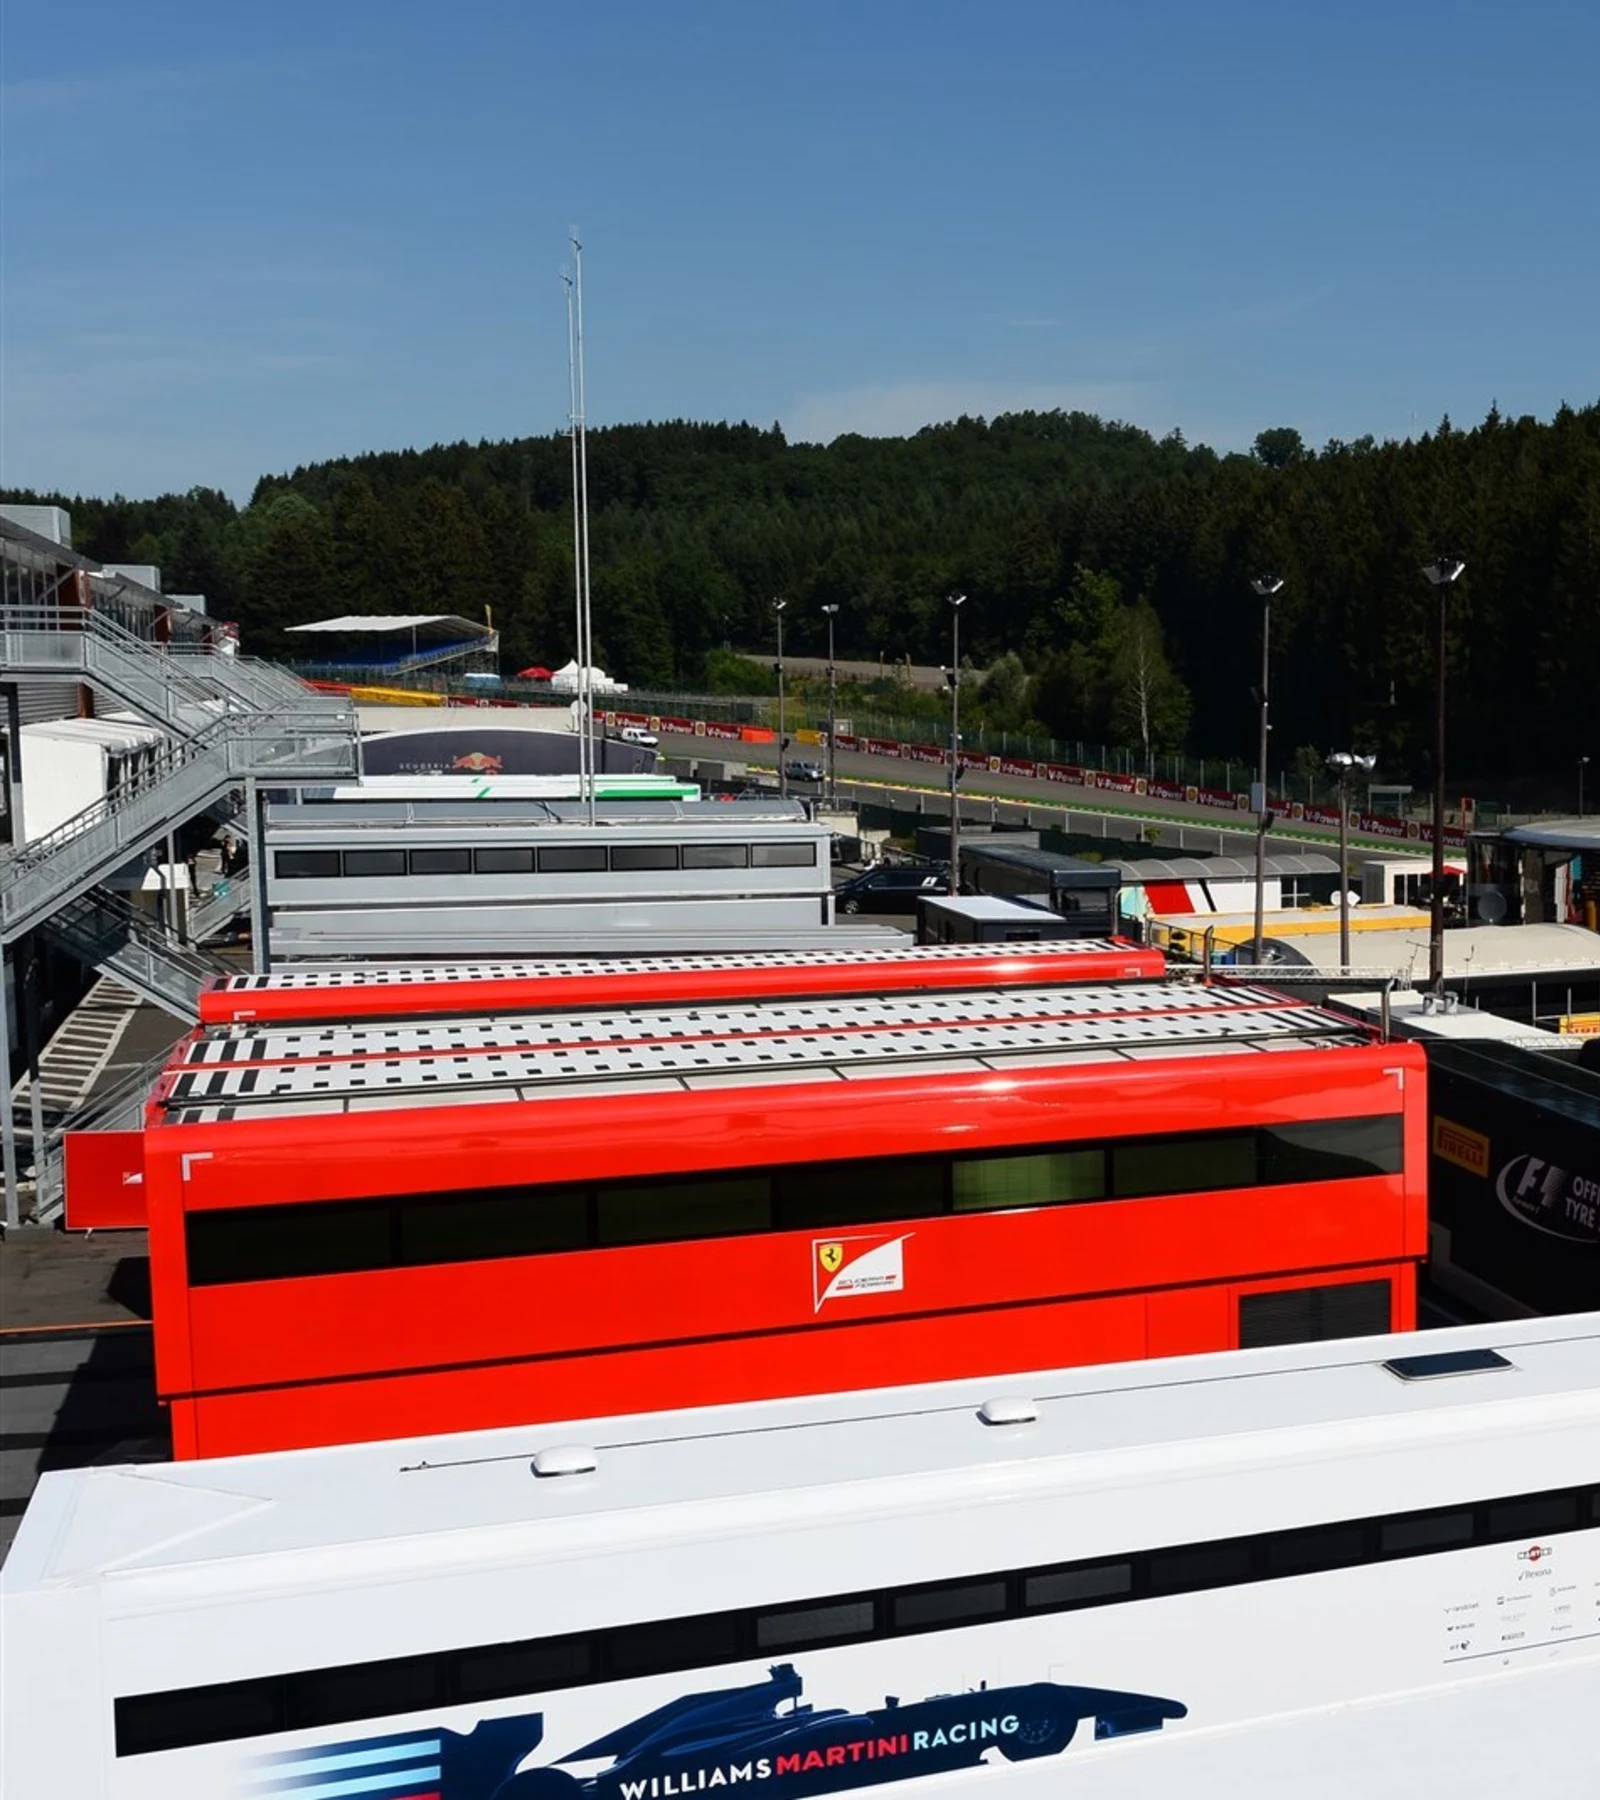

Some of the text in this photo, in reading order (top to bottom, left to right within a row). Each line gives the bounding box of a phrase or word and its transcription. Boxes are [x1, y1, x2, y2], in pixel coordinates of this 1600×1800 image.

[1097, 777, 1133, 793] V-Power
[1148, 785, 1184, 801] V-Power
[1199, 793, 1235, 809] V-Power
[1362, 820, 1404, 837] V-Power
[1437, 1125, 1484, 1167] PIRELLI
[1565, 1196, 1596, 1229] TYRE
[619, 1714, 1020, 1800] WILLIAMS MARTINI RACING
